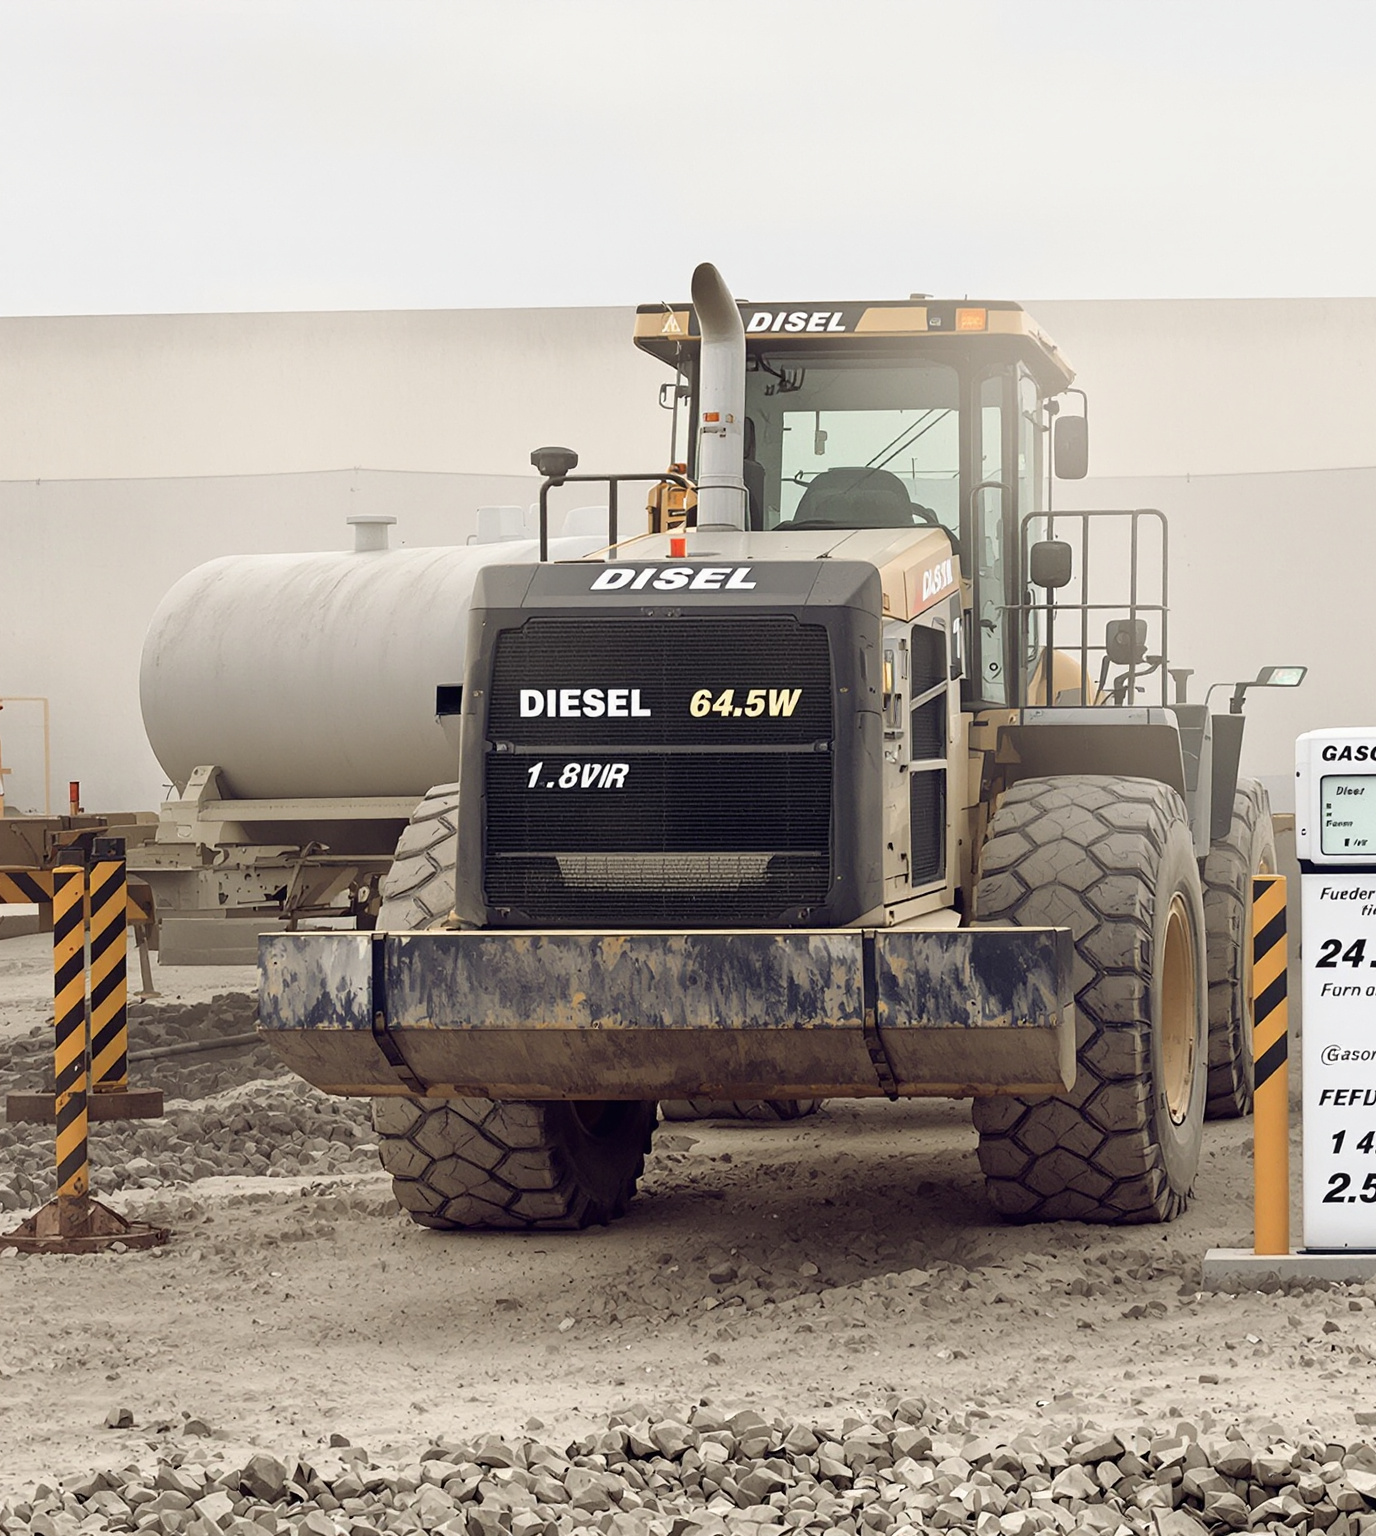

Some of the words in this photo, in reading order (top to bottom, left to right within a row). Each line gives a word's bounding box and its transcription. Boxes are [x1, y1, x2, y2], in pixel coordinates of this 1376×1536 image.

[746, 311, 846, 332] DISEL
[590, 567, 757, 590] DISEL
[519, 688, 651, 718] DIESEL
[689, 688, 803, 718] 64.5W
